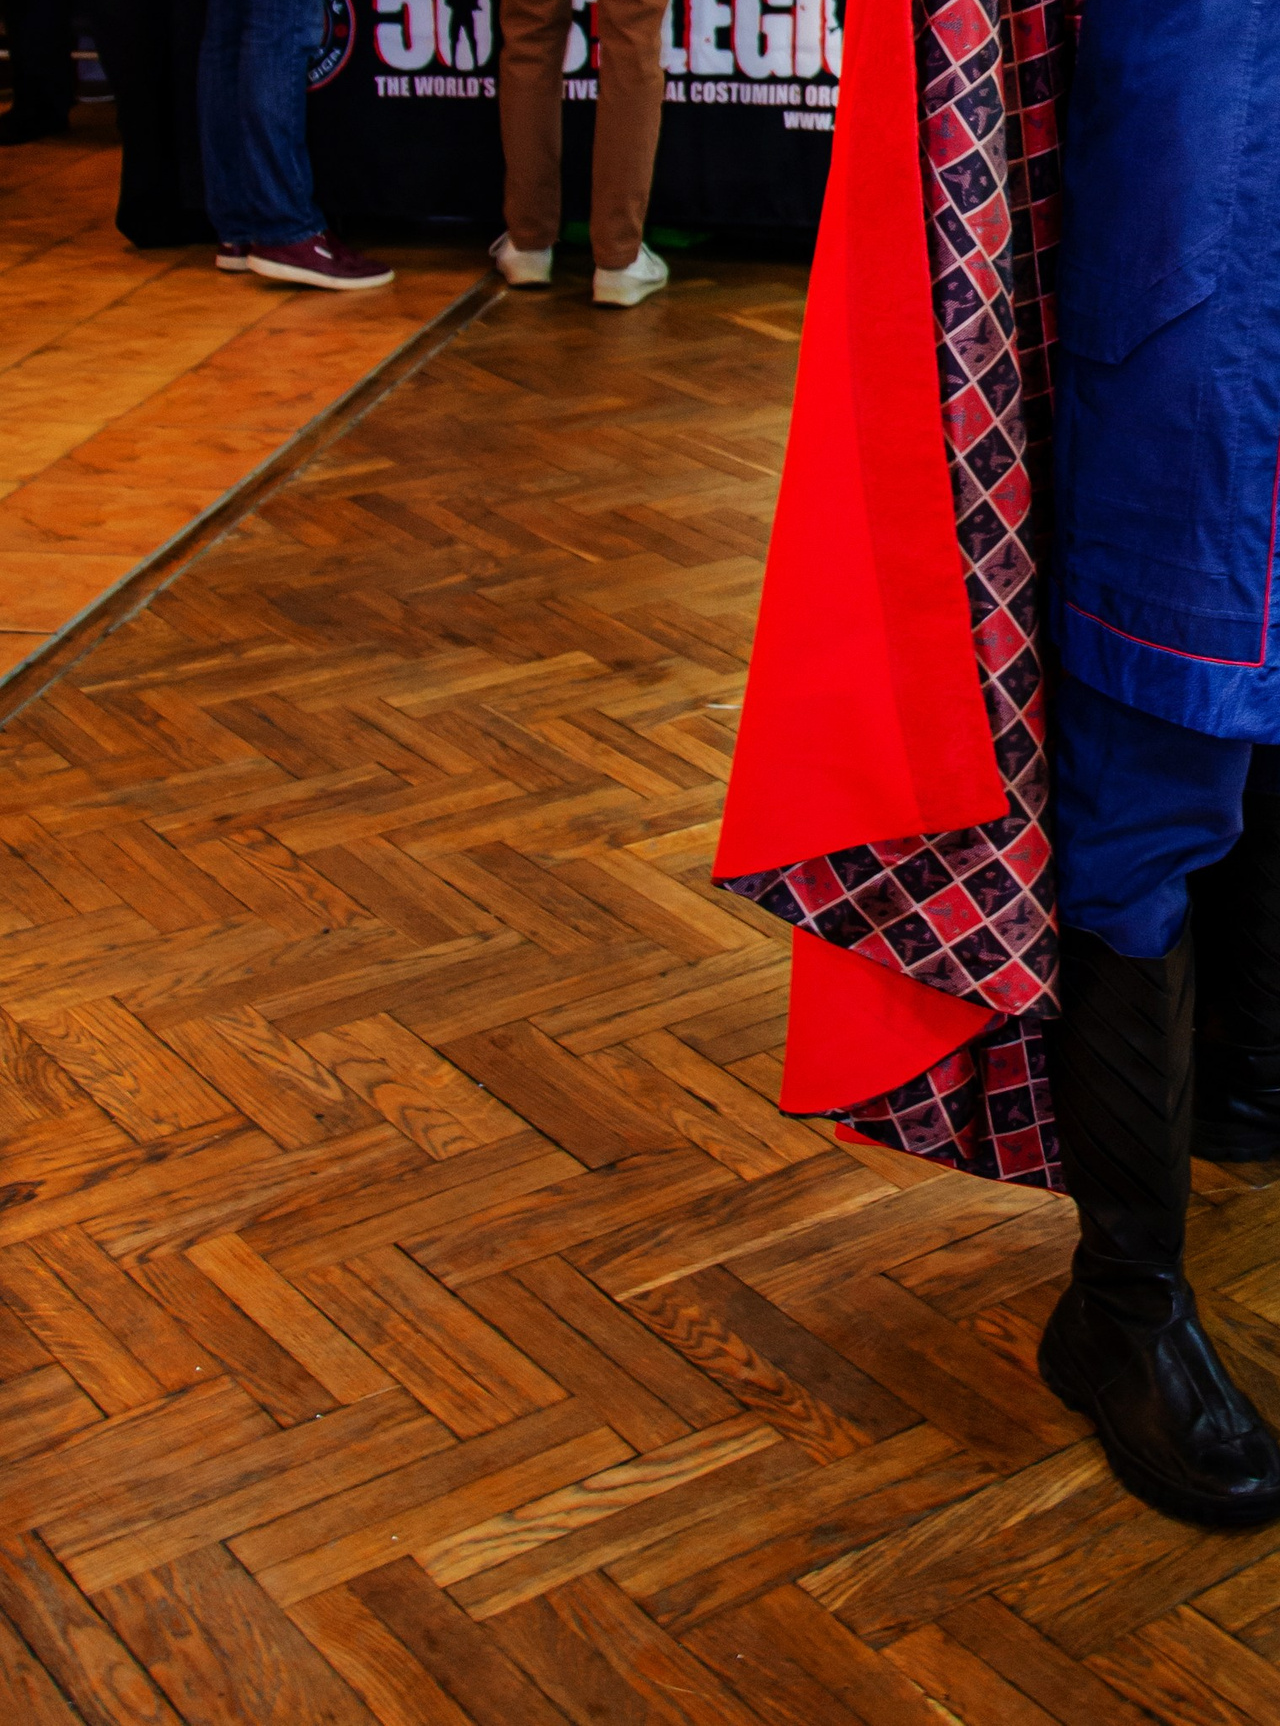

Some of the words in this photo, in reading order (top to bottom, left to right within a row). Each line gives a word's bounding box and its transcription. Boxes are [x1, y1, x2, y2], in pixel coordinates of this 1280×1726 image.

[374, 76, 410, 97] THE
[415, 77, 496, 98] WORLD'S
[691, 81, 801, 105] COSTUMING
